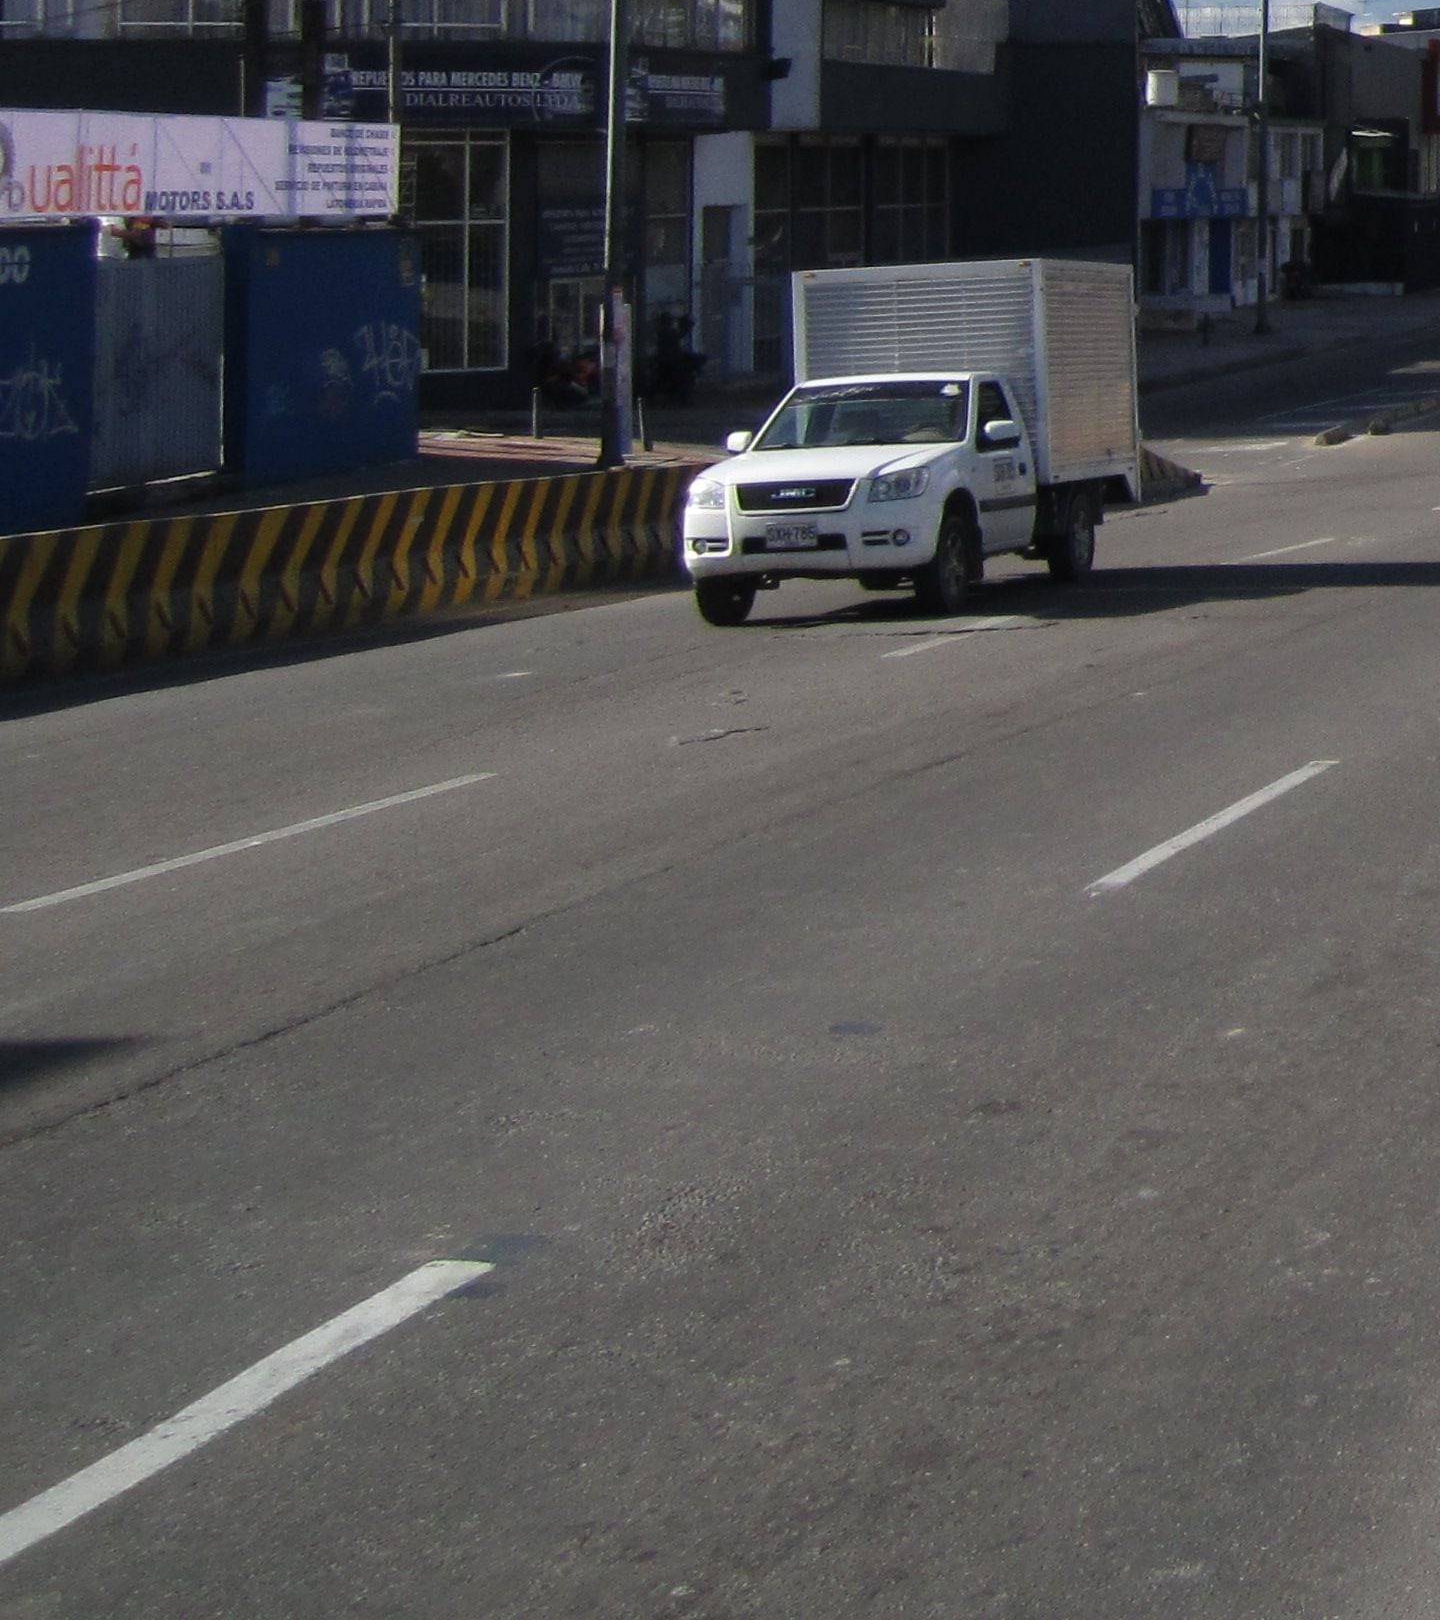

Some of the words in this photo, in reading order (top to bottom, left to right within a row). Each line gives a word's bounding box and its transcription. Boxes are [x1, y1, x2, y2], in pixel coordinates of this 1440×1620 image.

[418, 71, 447, 86] PARA
[450, 71, 508, 87] MERCEDES
[511, 72, 541, 87] BENZ
[145, 190, 211, 211] MOTORS
